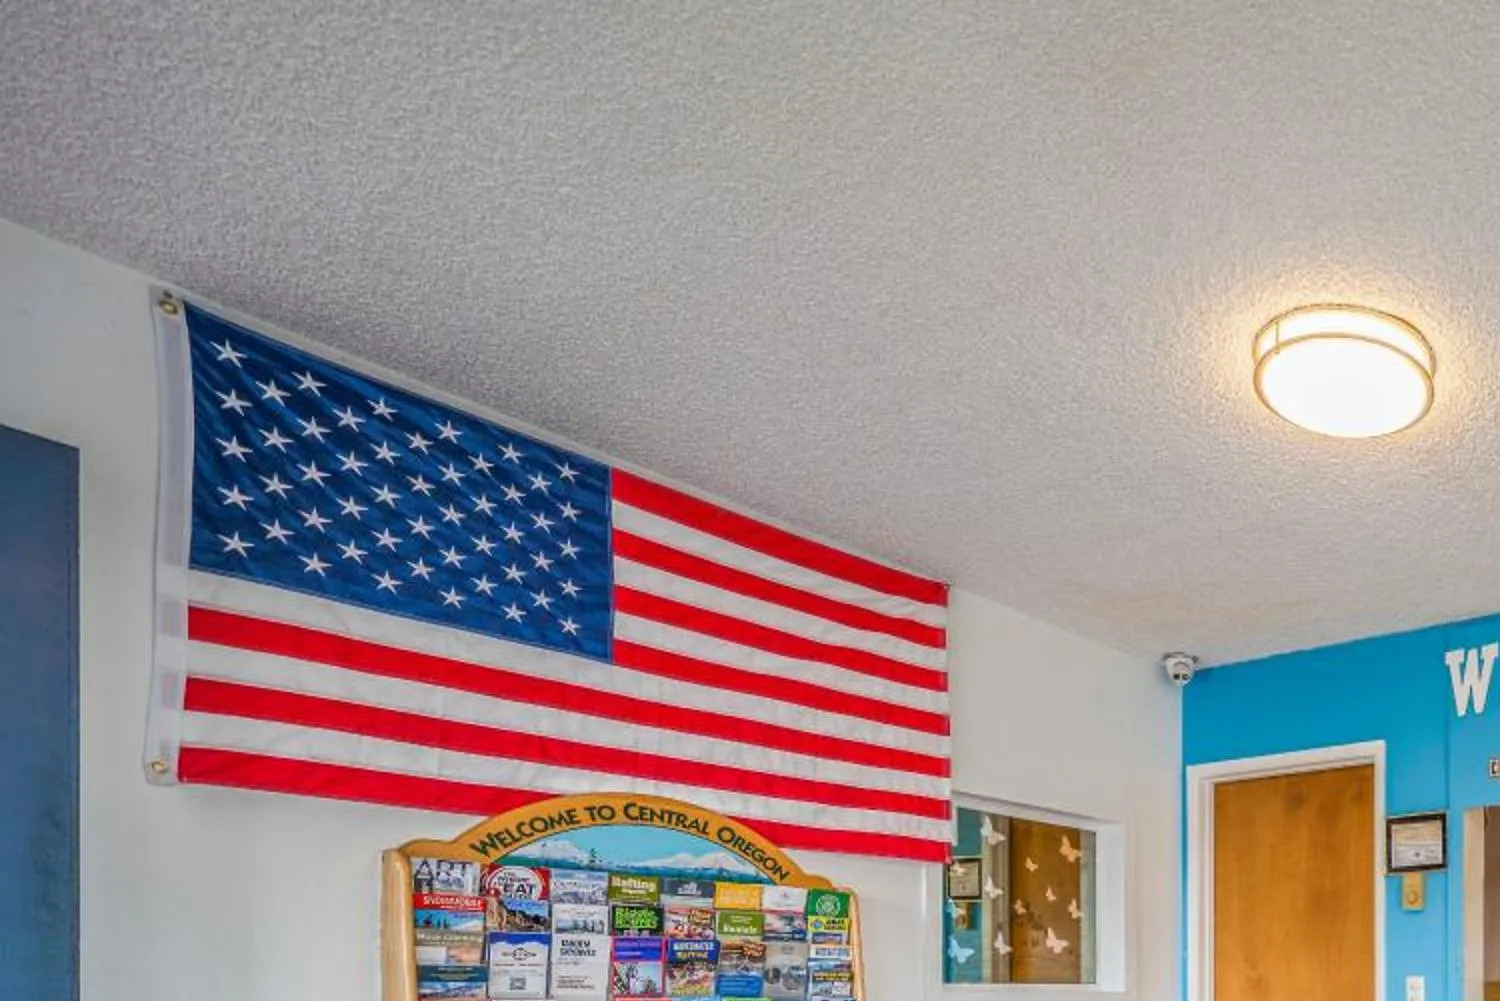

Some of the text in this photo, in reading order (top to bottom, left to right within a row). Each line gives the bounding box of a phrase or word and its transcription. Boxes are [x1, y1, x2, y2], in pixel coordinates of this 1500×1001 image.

[470, 801, 791, 883] WELCOME TO CENTRAL OREGON
